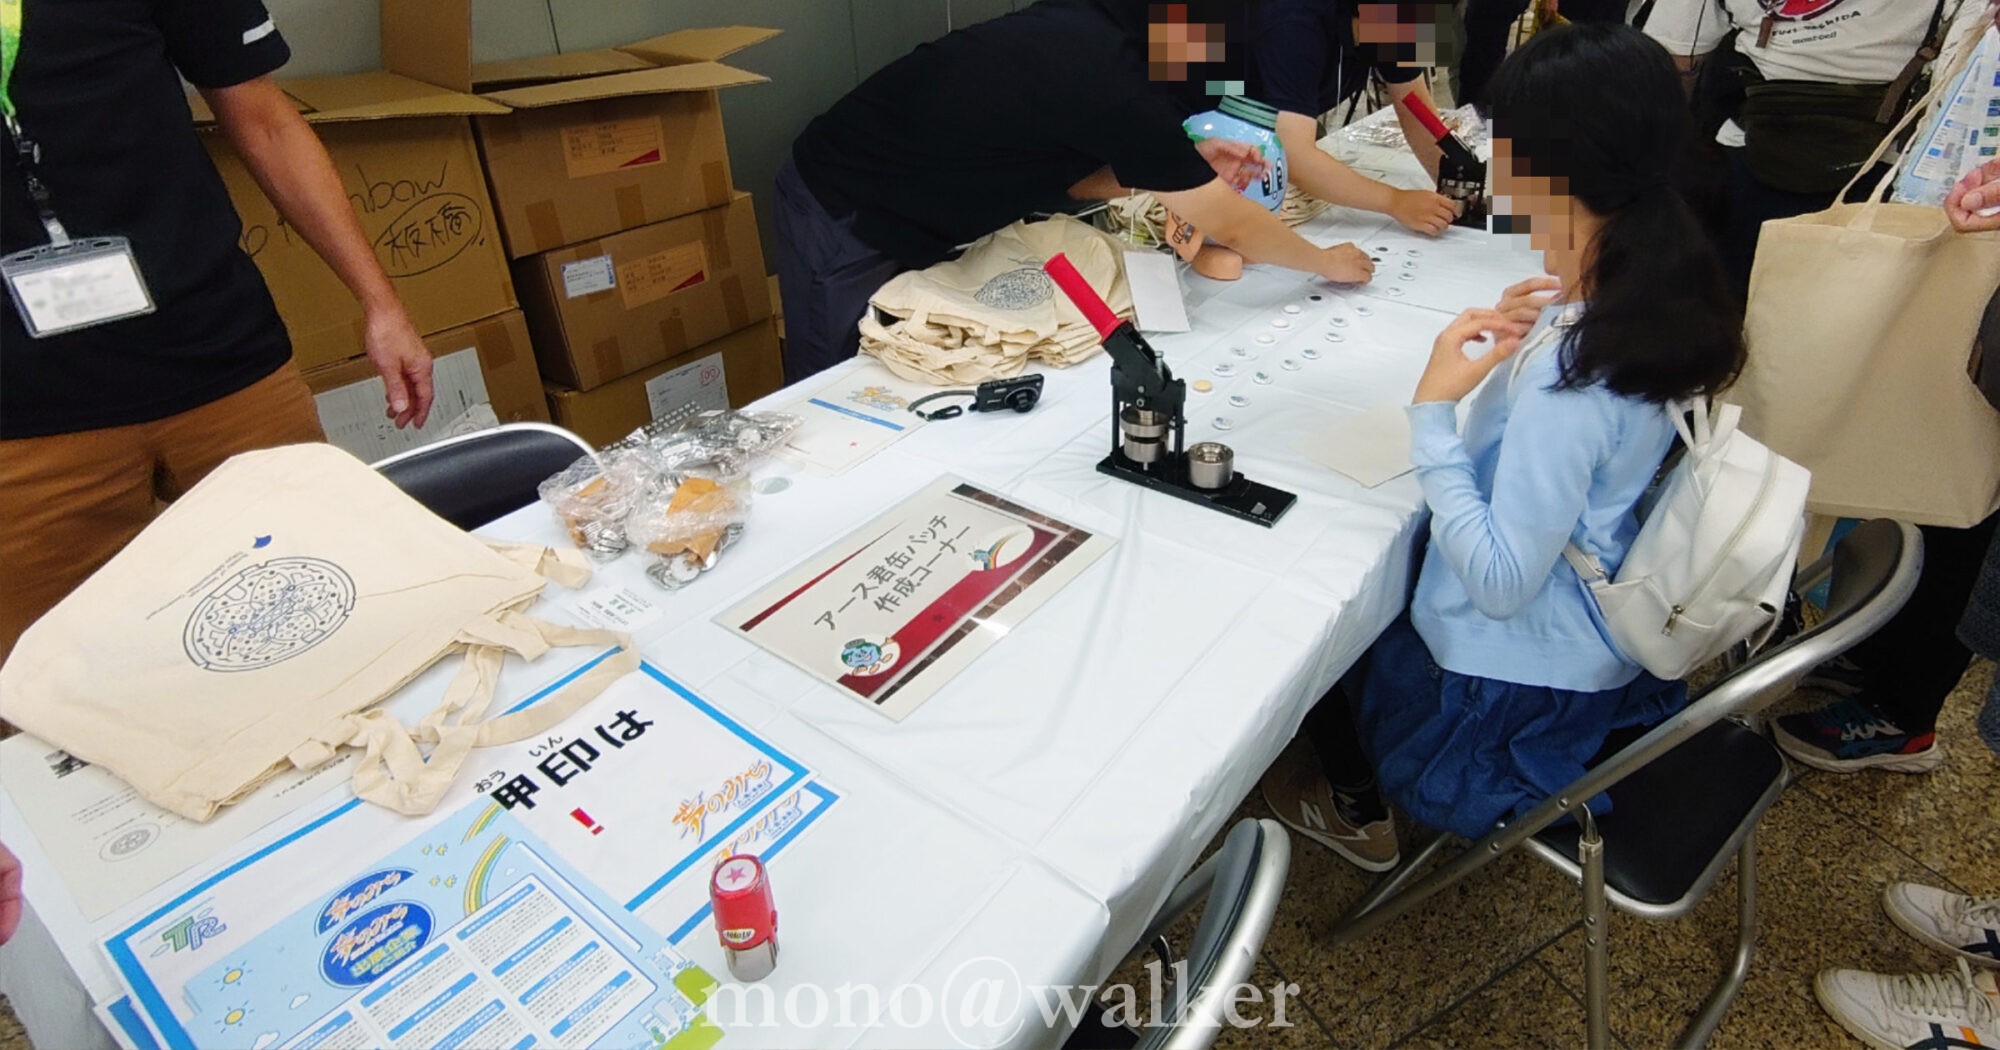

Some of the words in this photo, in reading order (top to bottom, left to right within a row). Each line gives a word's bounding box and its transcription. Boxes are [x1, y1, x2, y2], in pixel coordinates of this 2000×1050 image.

[873, 526, 971, 613] 作成コーナー
[473, 770, 506, 793] おう
[528, 735, 563, 757] いん
